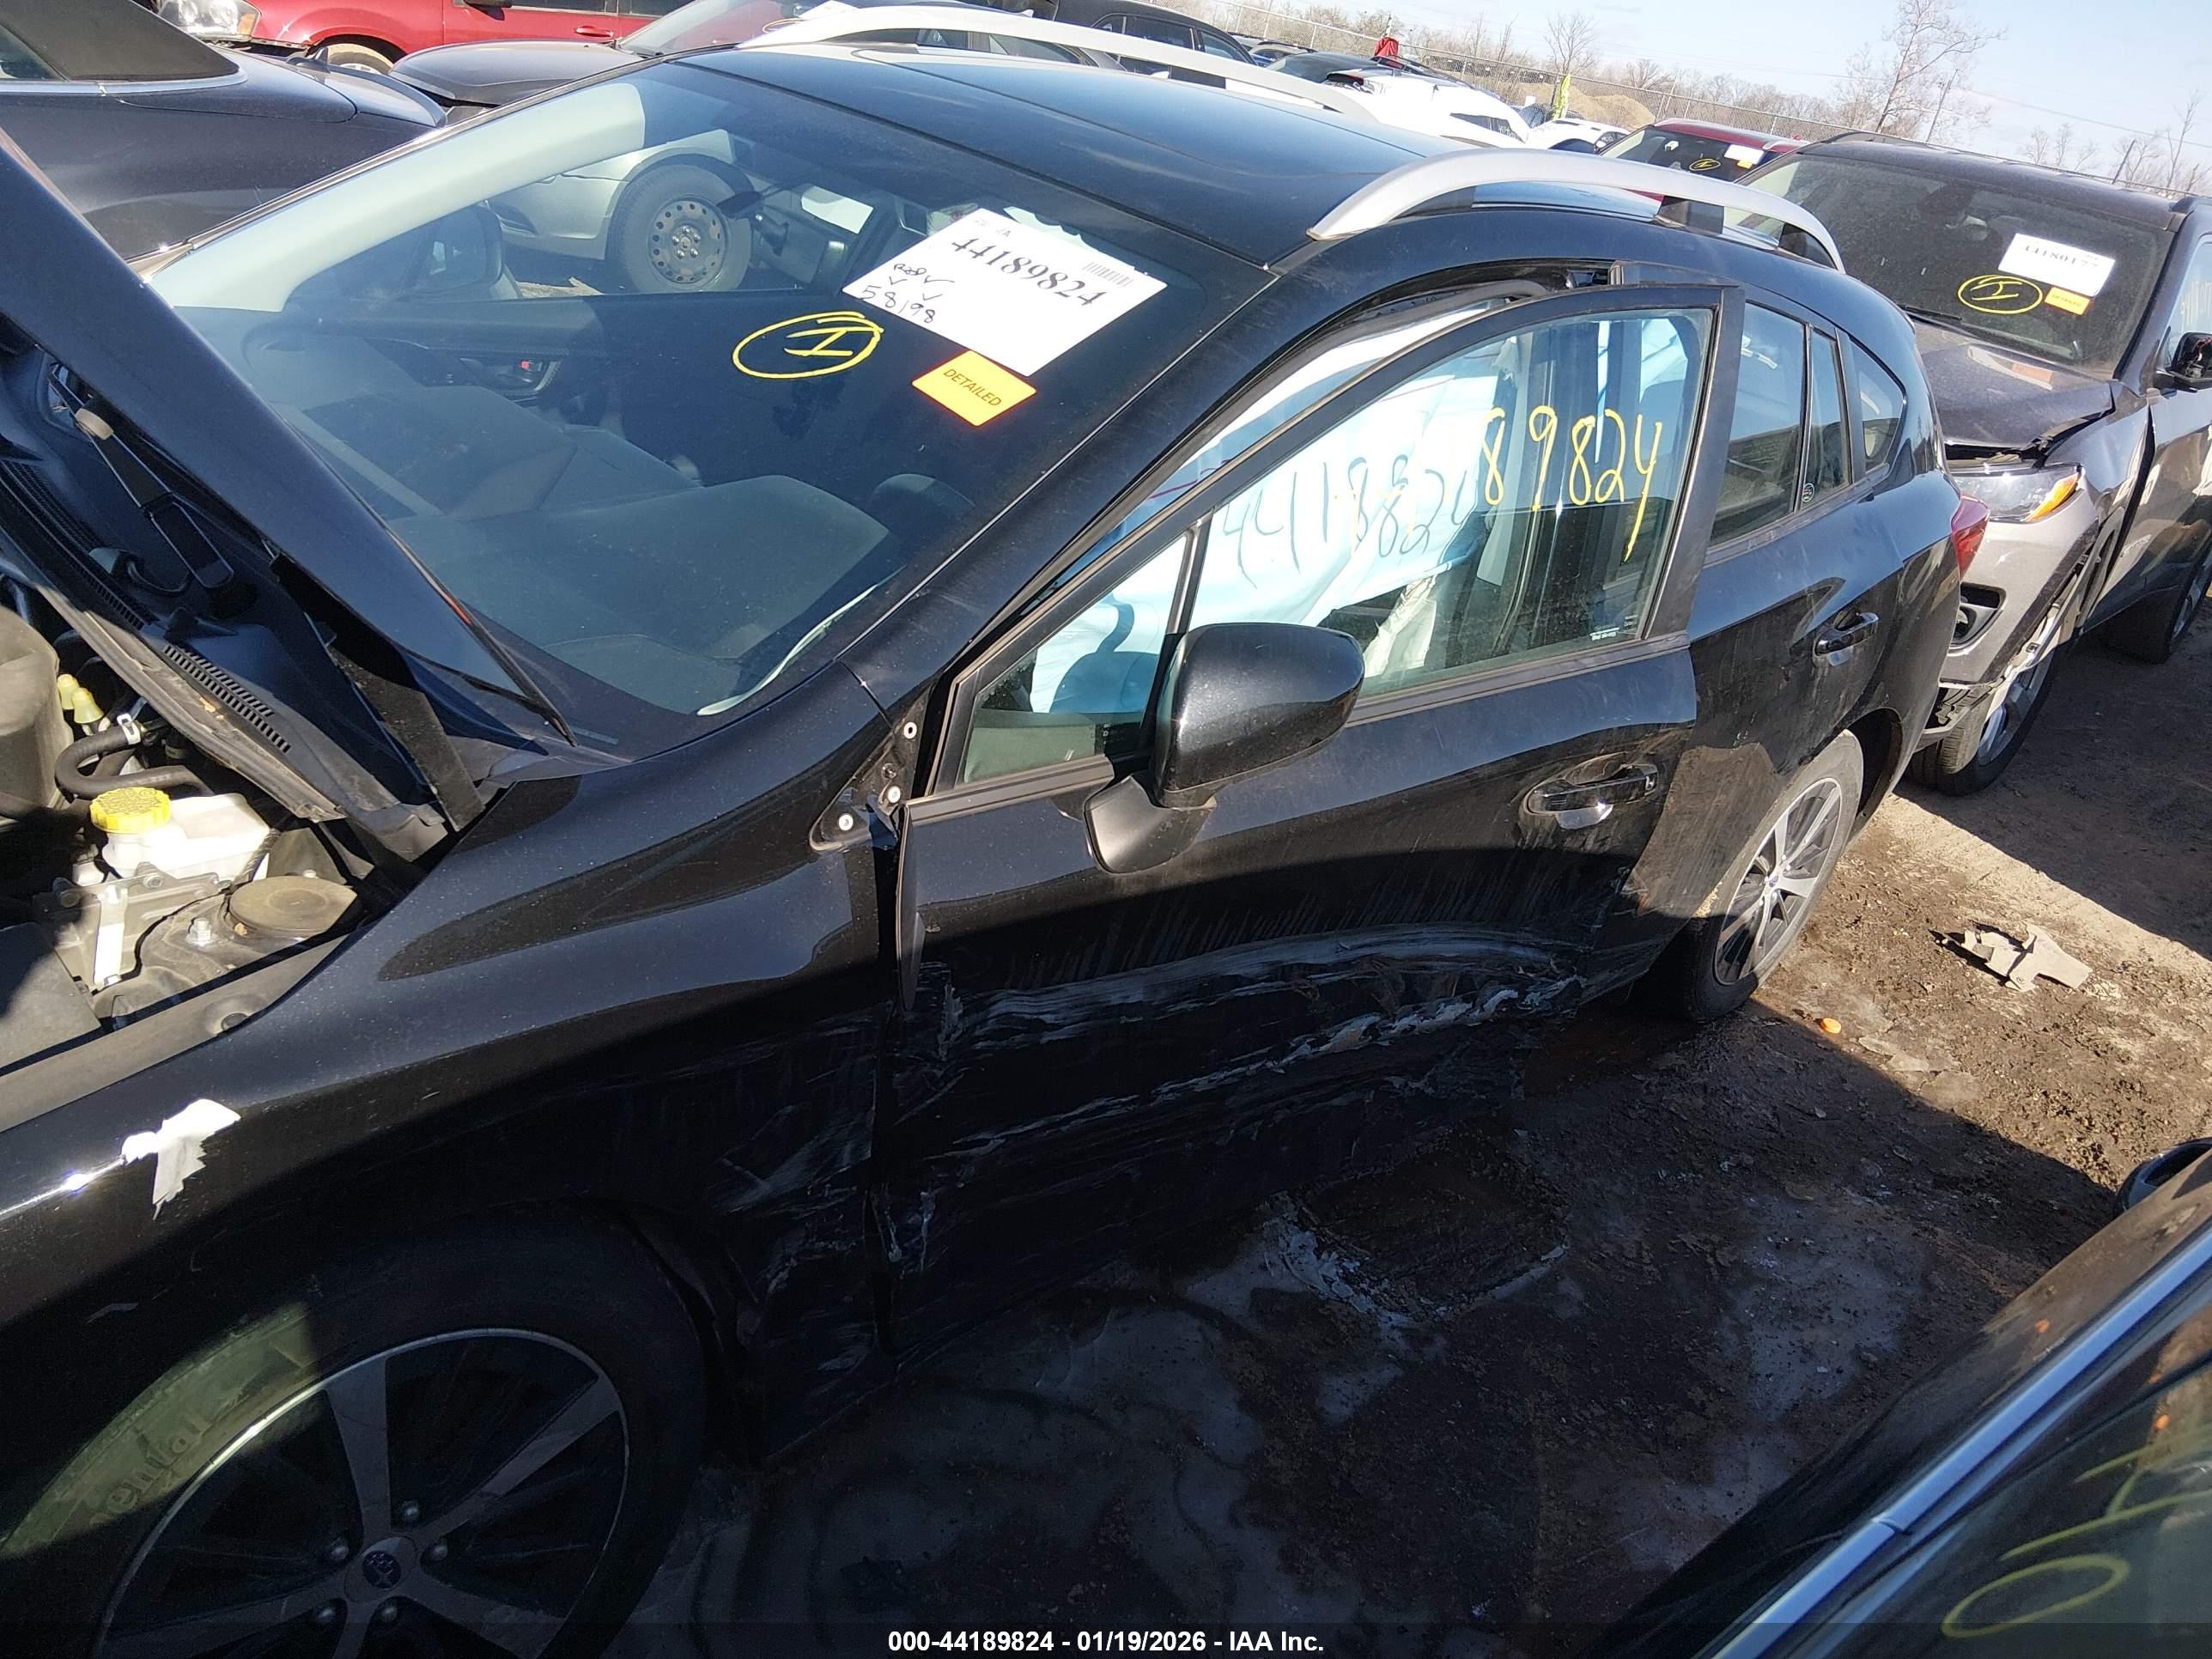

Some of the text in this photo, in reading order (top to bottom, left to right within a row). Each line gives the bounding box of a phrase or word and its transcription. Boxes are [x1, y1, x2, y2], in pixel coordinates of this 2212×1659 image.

[951, 237, 1107, 307] 44189824
[943, 368, 1003, 407] DETAILED
[1480, 404, 1663, 563] 89824
